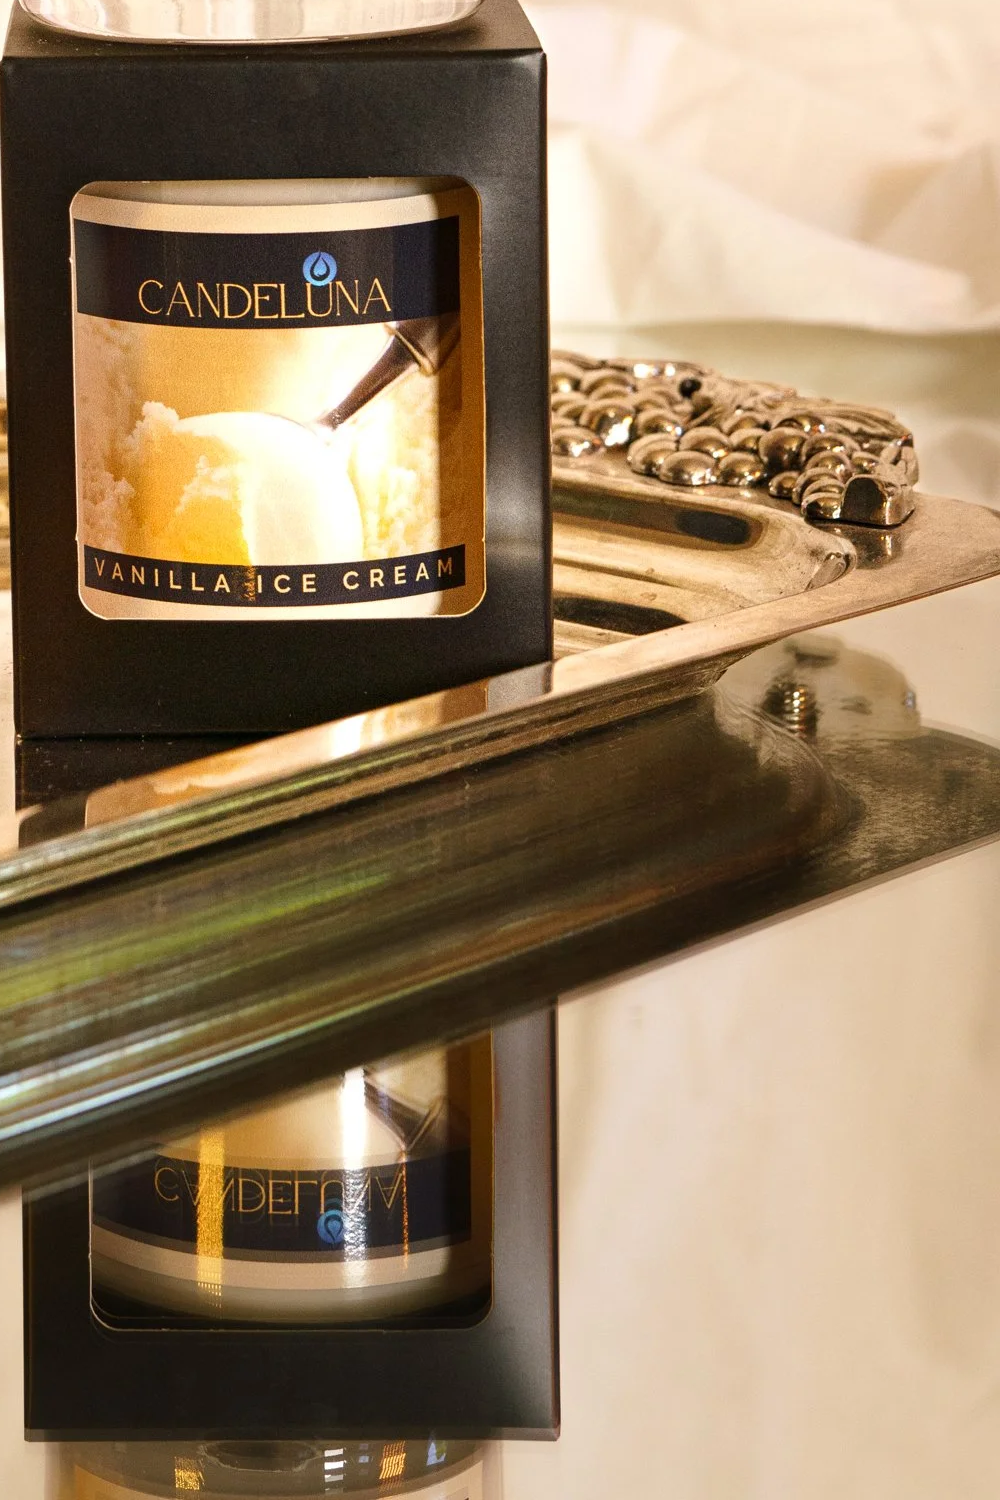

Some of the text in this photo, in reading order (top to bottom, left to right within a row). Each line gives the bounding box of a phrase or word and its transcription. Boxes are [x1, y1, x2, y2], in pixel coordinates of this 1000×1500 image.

[138, 278, 392, 320] CANDELUNA
[94, 557, 454, 594] VANILLA ICE CREAM
